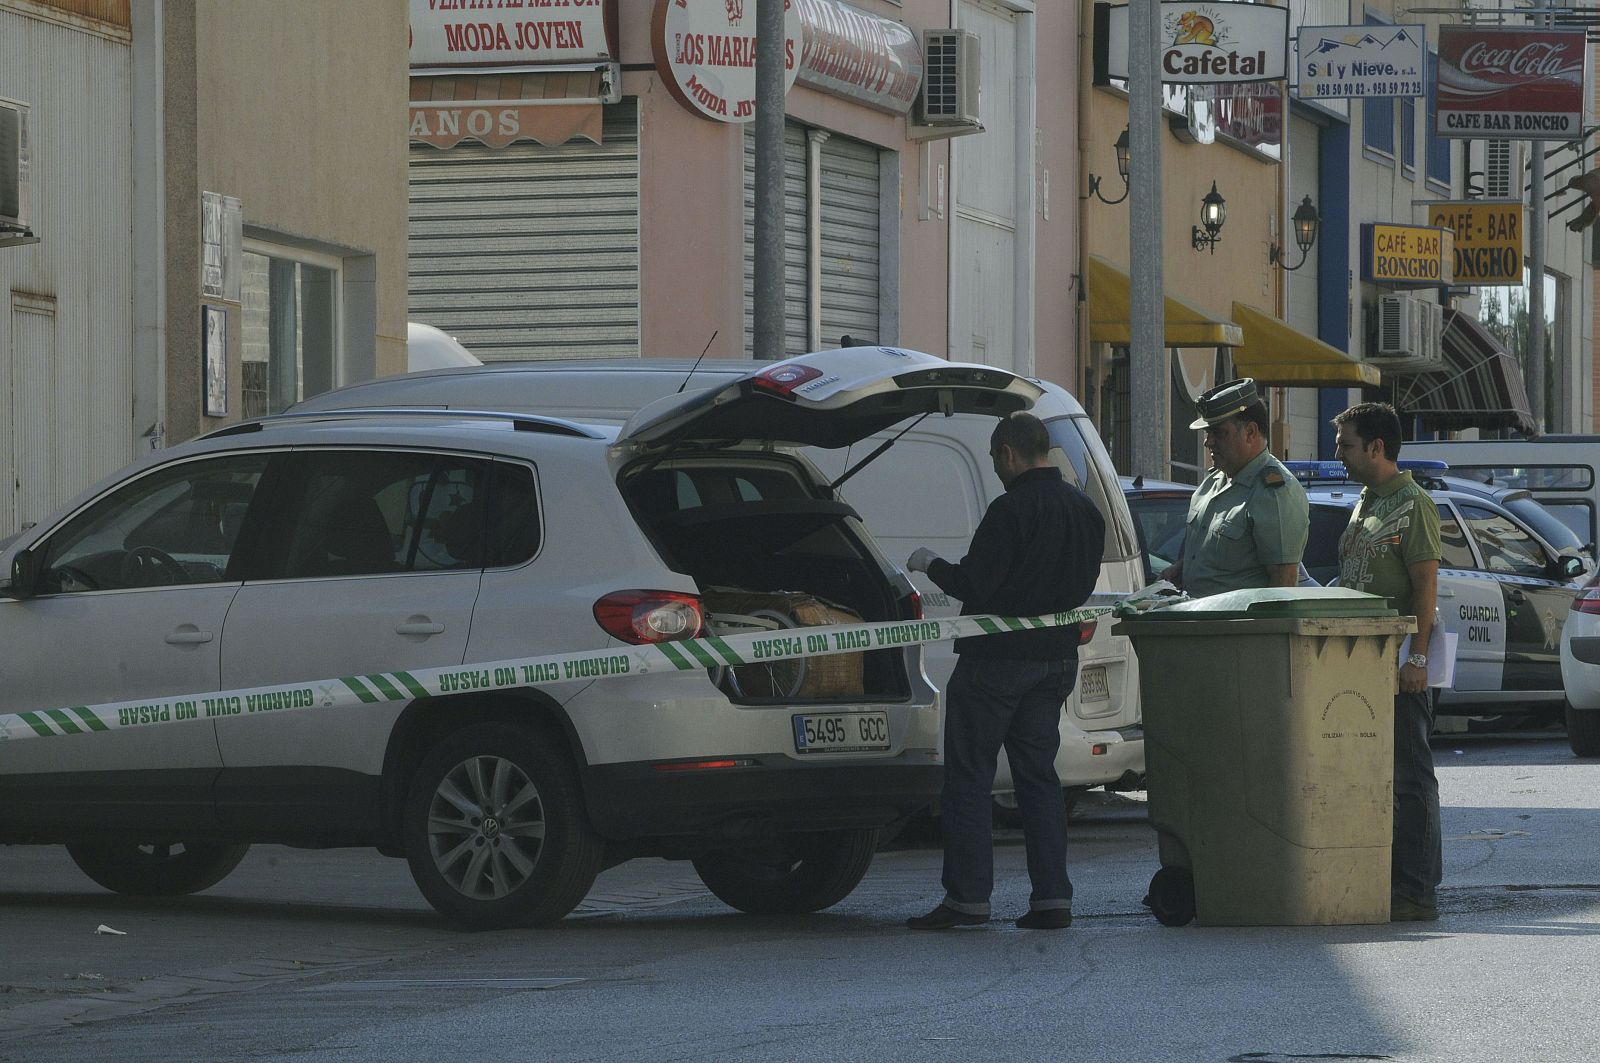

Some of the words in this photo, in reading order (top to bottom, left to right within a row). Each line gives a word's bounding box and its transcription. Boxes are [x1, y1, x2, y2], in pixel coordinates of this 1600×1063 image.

[444, 23, 511, 52] MODA
[515, 21, 584, 51] JOVEN
[675, 32, 704, 65] LOS
[707, 34, 794, 70] MARIAS
[1163, 49, 1266, 76] Cafetal
[1459, 41, 1570, 75] Coca-Cola
[1337, 66, 1346, 79] y
[686, 74, 727, 116] MODA
[1316, 83, 1330, 96] 958
[1332, 83, 1342, 96] 50
[1344, 83, 1353, 95] 90
[1355, 82, 1365, 95] 82
[1373, 82, 1387, 94] 958
[1389, 82, 1398, 94] 59
[1400, 82, 1410, 94] 72
[1412, 82, 1421, 94] 25
[409, 109, 520, 136] ANOS
[1446, 113, 1481, 129] CAFE
[1483, 113, 1511, 130] BAR
[1514, 113, 1569, 131] RONCHO
[1488, 213, 1517, 241] BAR
[1377, 231, 1406, 254] CAFÉ
[1417, 236, 1439, 256] BAR
[1453, 246, 1518, 278] ONCHO
[1459, 604, 1500, 622] GUARDIA
[807, 634, 829, 653] NO
[832, 629, 871, 650] CIVIL
[874, 621, 941, 646] GUARDIA
[1468, 625, 1491, 643] CIVIL
[752, 638, 803, 659] PASAR
[495, 665, 516, 687] NO
[521, 661, 560, 686] CIVIL
[563, 654, 630, 680] GUARDIA
[438, 669, 490, 692] PASAR
[175, 701, 198, 721] NO
[206, 696, 242, 718] CIVIL
[245, 688, 314, 713] GUARDIA
[118, 704, 170, 726] PASAR
[804, 718, 846, 744] 5495
[858, 717, 886, 742] GCC
